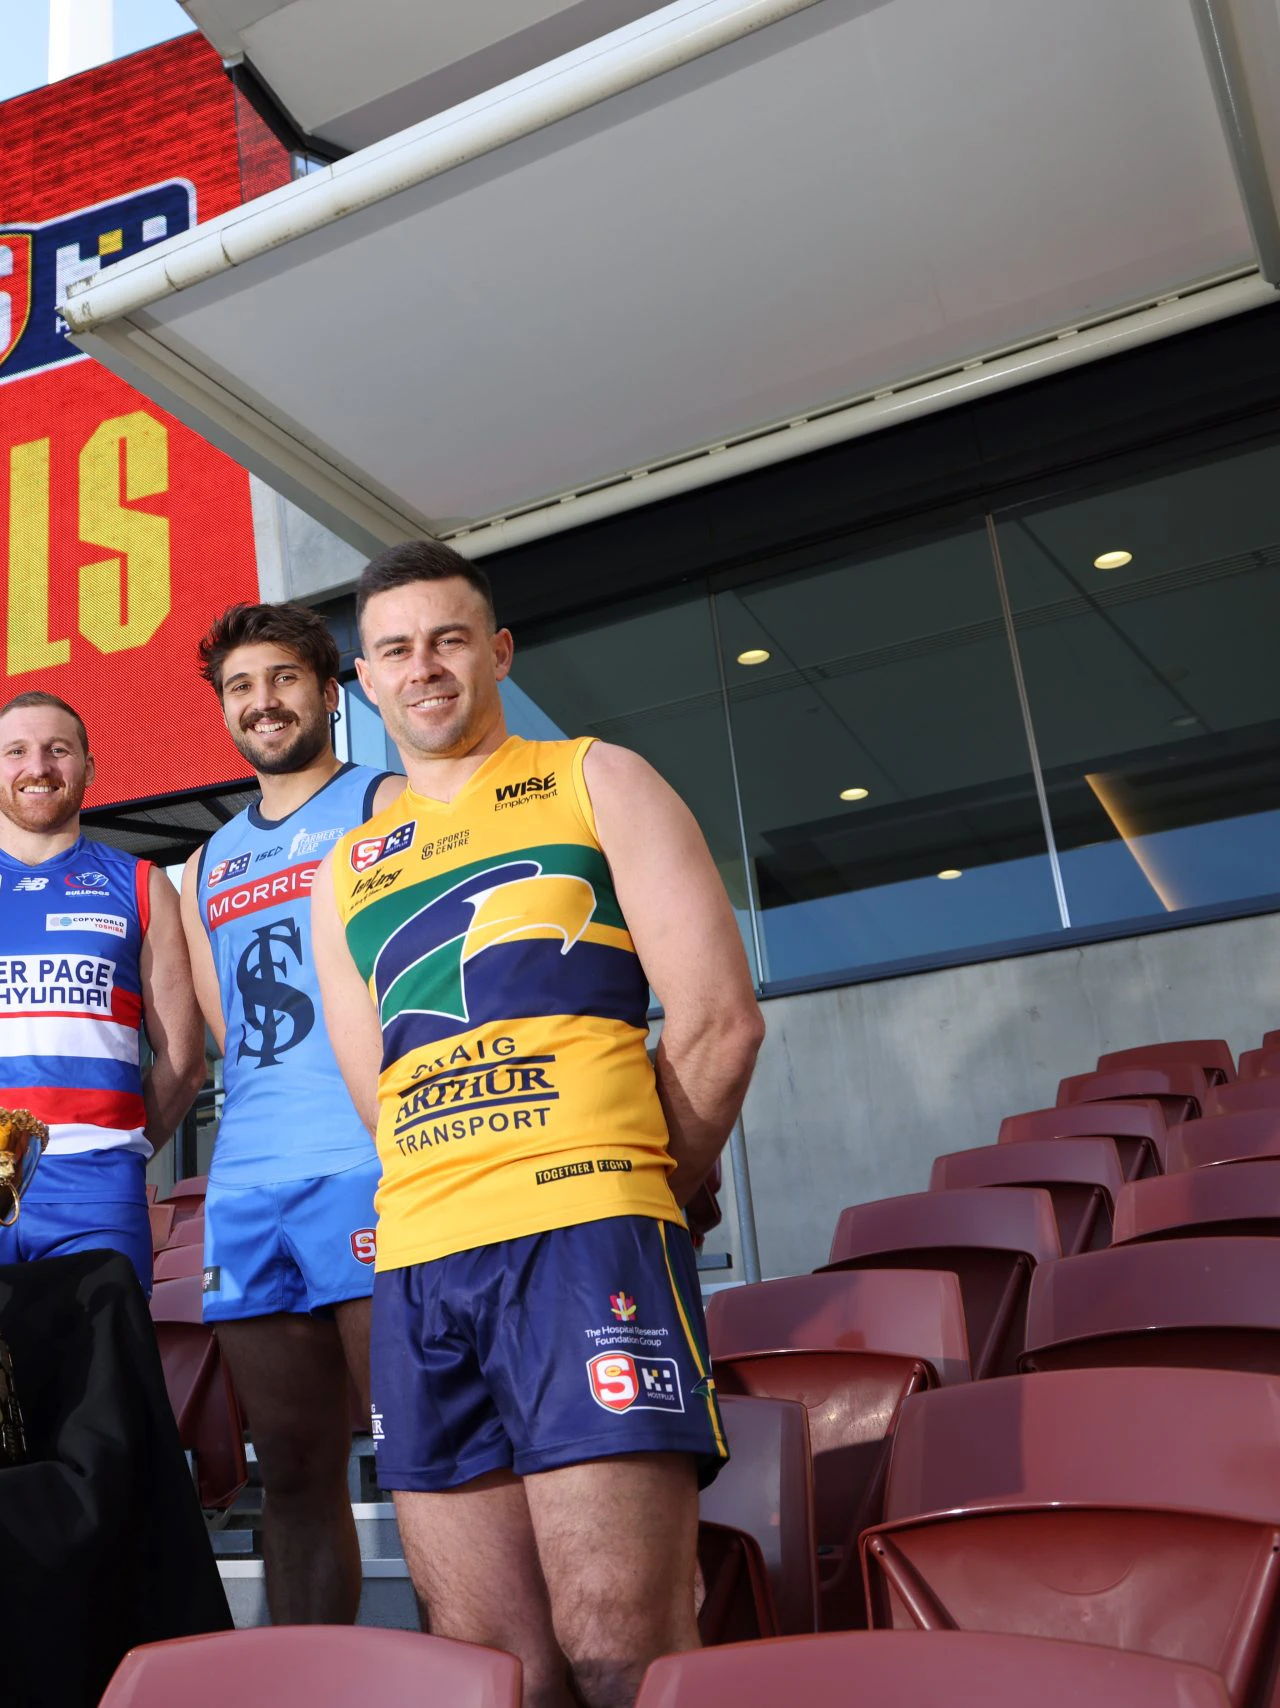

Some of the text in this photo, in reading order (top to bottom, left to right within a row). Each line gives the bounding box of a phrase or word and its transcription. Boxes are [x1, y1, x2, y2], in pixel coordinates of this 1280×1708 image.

[495, 772, 557, 802] WISE
[494, 789, 558, 812] Employment
[436, 837, 469, 855] CENTRE
[437, 829, 470, 846] SPORTS
[73, 917, 125, 927] COPYWORLD
[94, 923, 124, 934] TOSHIBA
[39, 959, 111, 987] PAGE
[395, 1067, 555, 1123] ARTHUR
[395, 1107, 551, 1157] TRANSPORT
[585, 1325, 668, 1339] The Hospital Research
[595, 1335, 662, 1347] Foundation Group
[647, 1391, 675, 1401] HOSTPLUS
